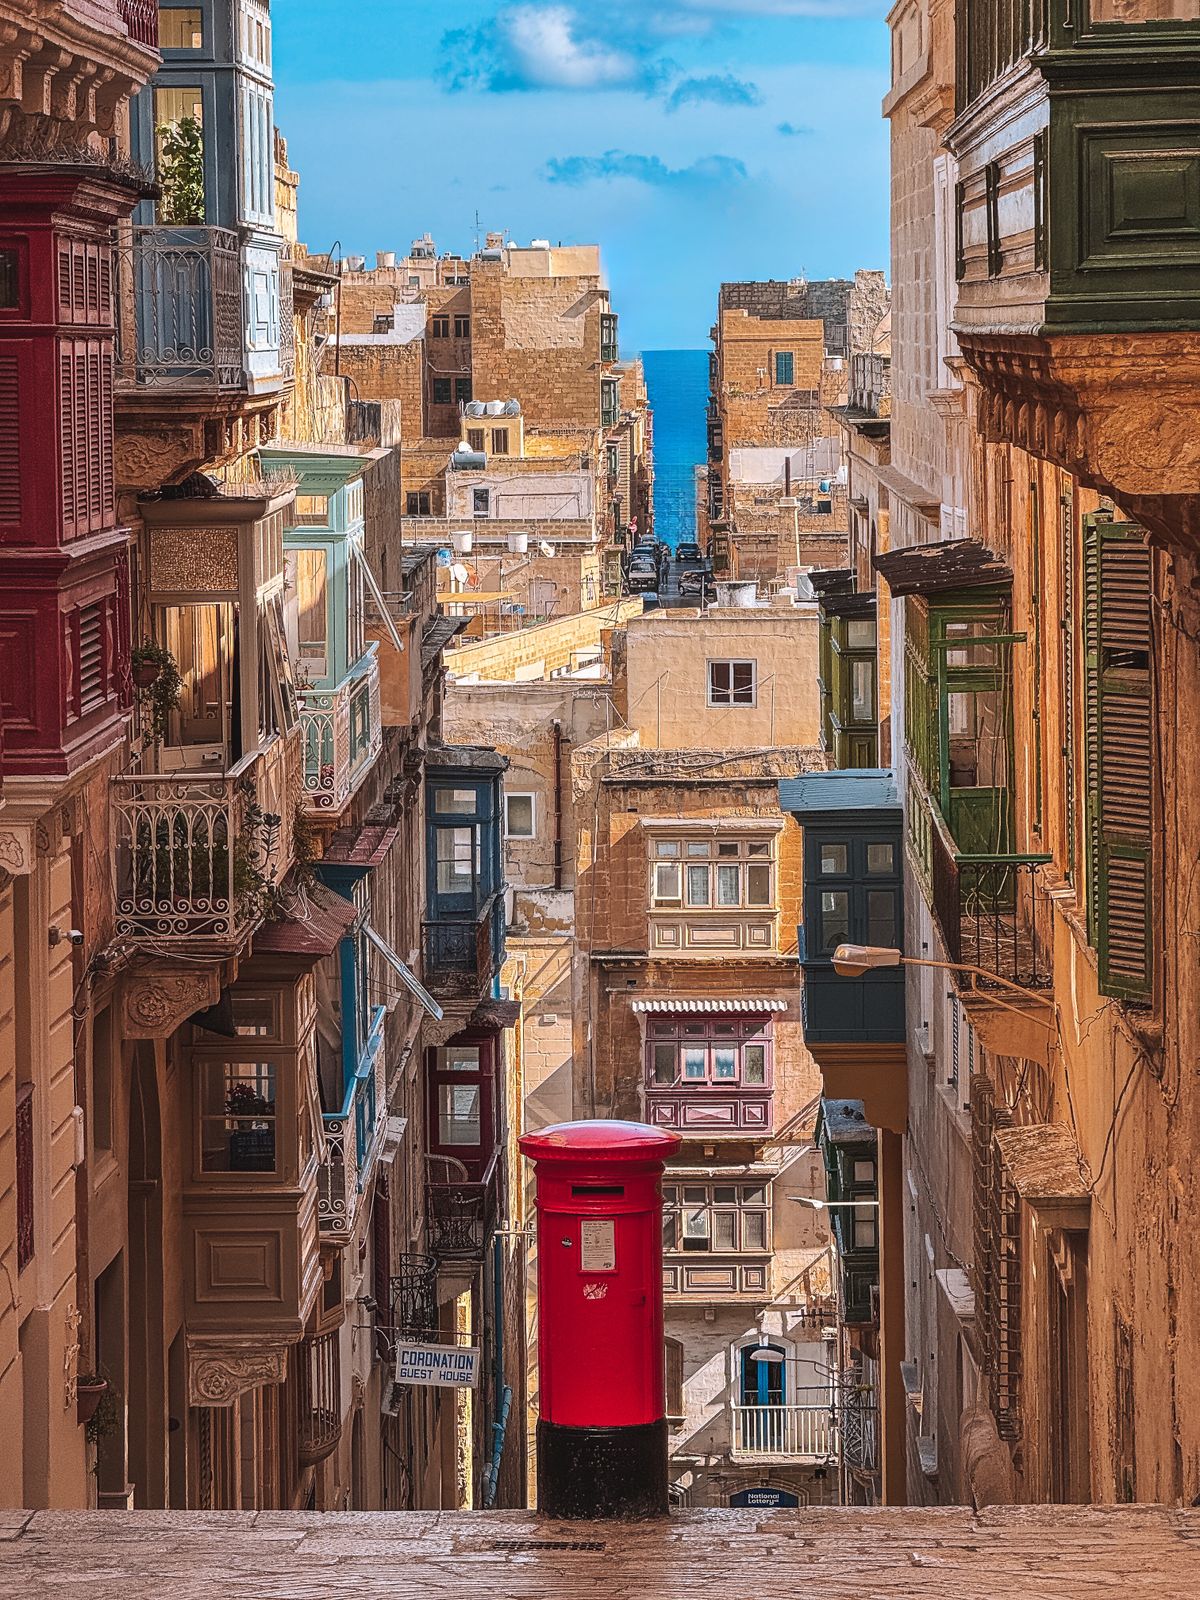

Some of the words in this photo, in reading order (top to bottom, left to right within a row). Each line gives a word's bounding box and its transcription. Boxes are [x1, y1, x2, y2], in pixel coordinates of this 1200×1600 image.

[401, 1350, 474, 1370] CORONATION
[400, 1368, 433, 1379] GUEST
[439, 1371, 473, 1382] HOUSE
